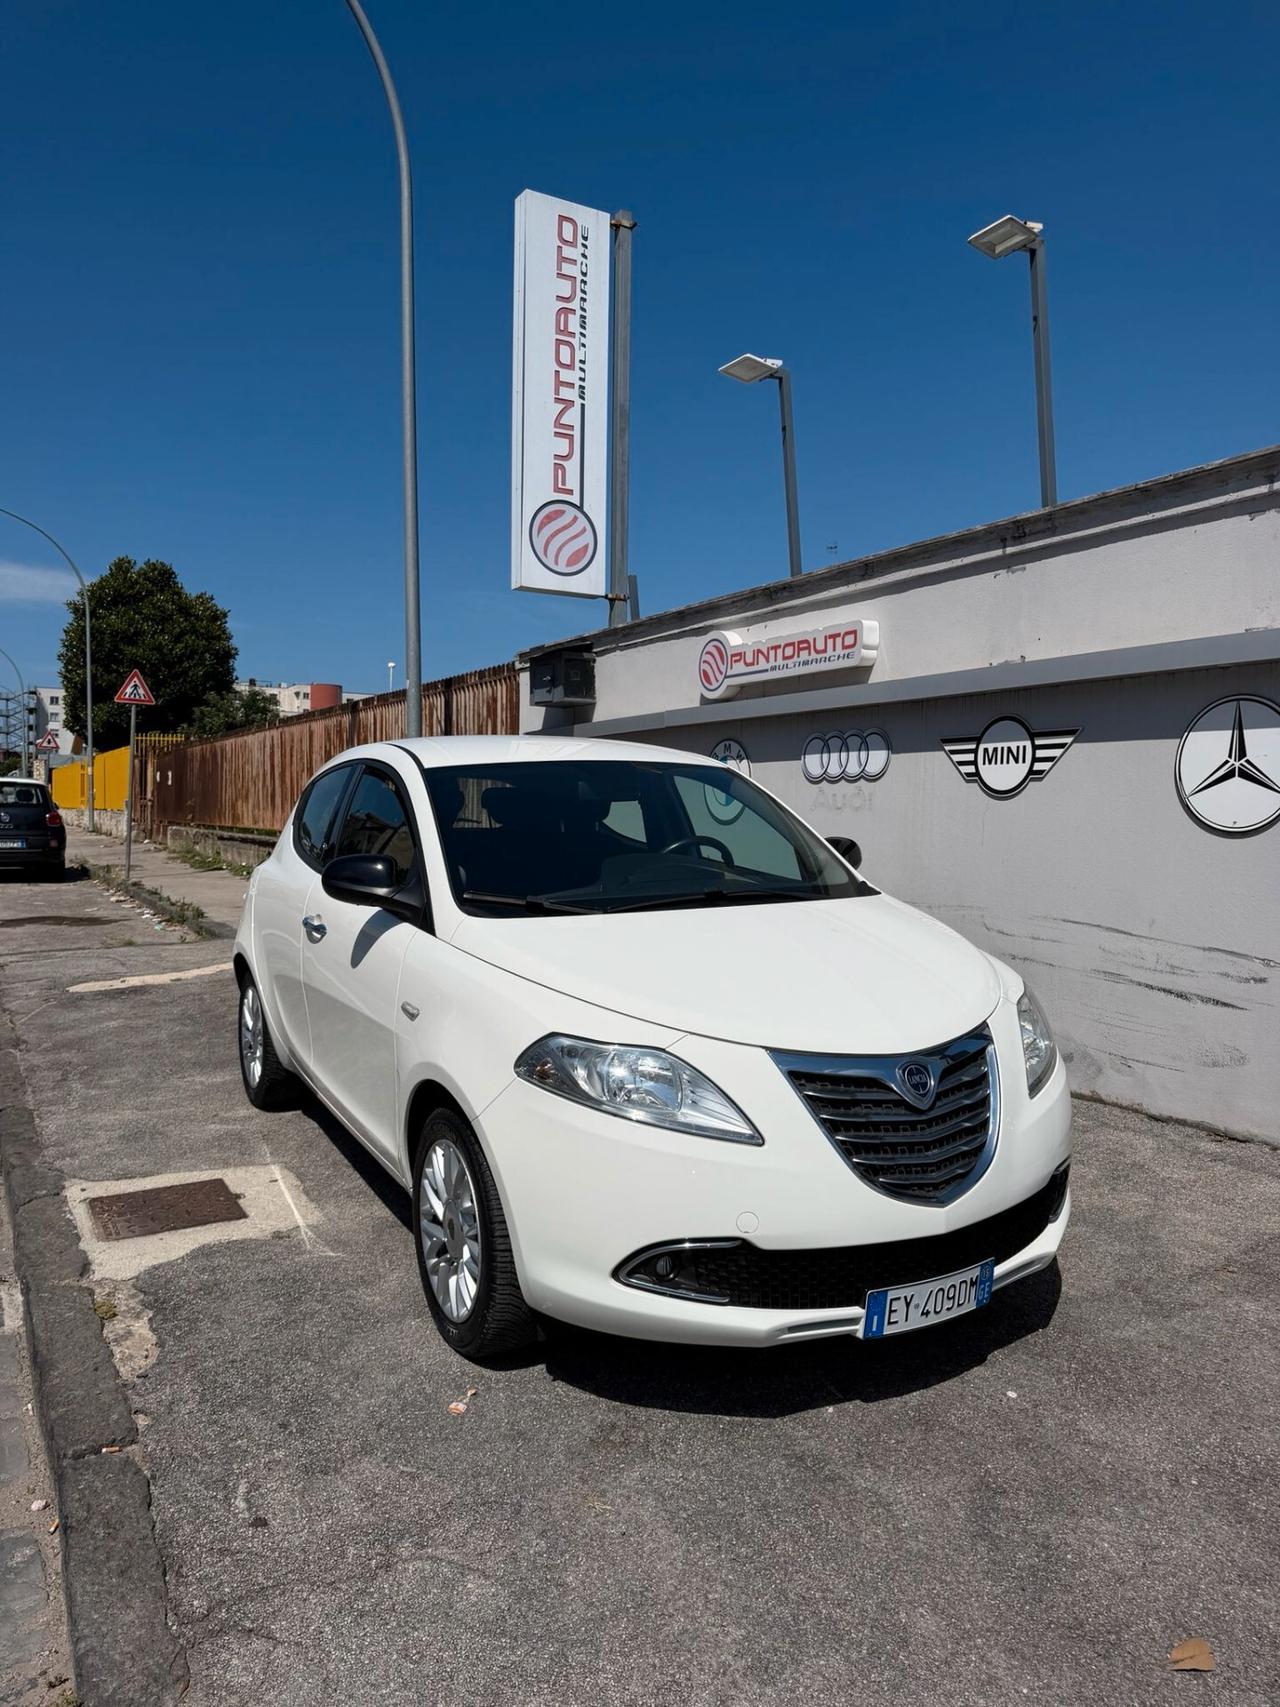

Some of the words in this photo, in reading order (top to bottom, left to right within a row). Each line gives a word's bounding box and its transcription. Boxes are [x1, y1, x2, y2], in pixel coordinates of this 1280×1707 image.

[578, 224, 589, 402] MULTIMARCHE
[553, 214, 579, 496] PUNTOAUTO
[729, 629, 858, 670] PUNTOAUTO
[769, 651, 856, 673] MULTIMARCHE
[982, 744, 1027, 766] MINI
[887, 1293, 915, 1326] EY
[920, 1273, 980, 1318] 409DM
